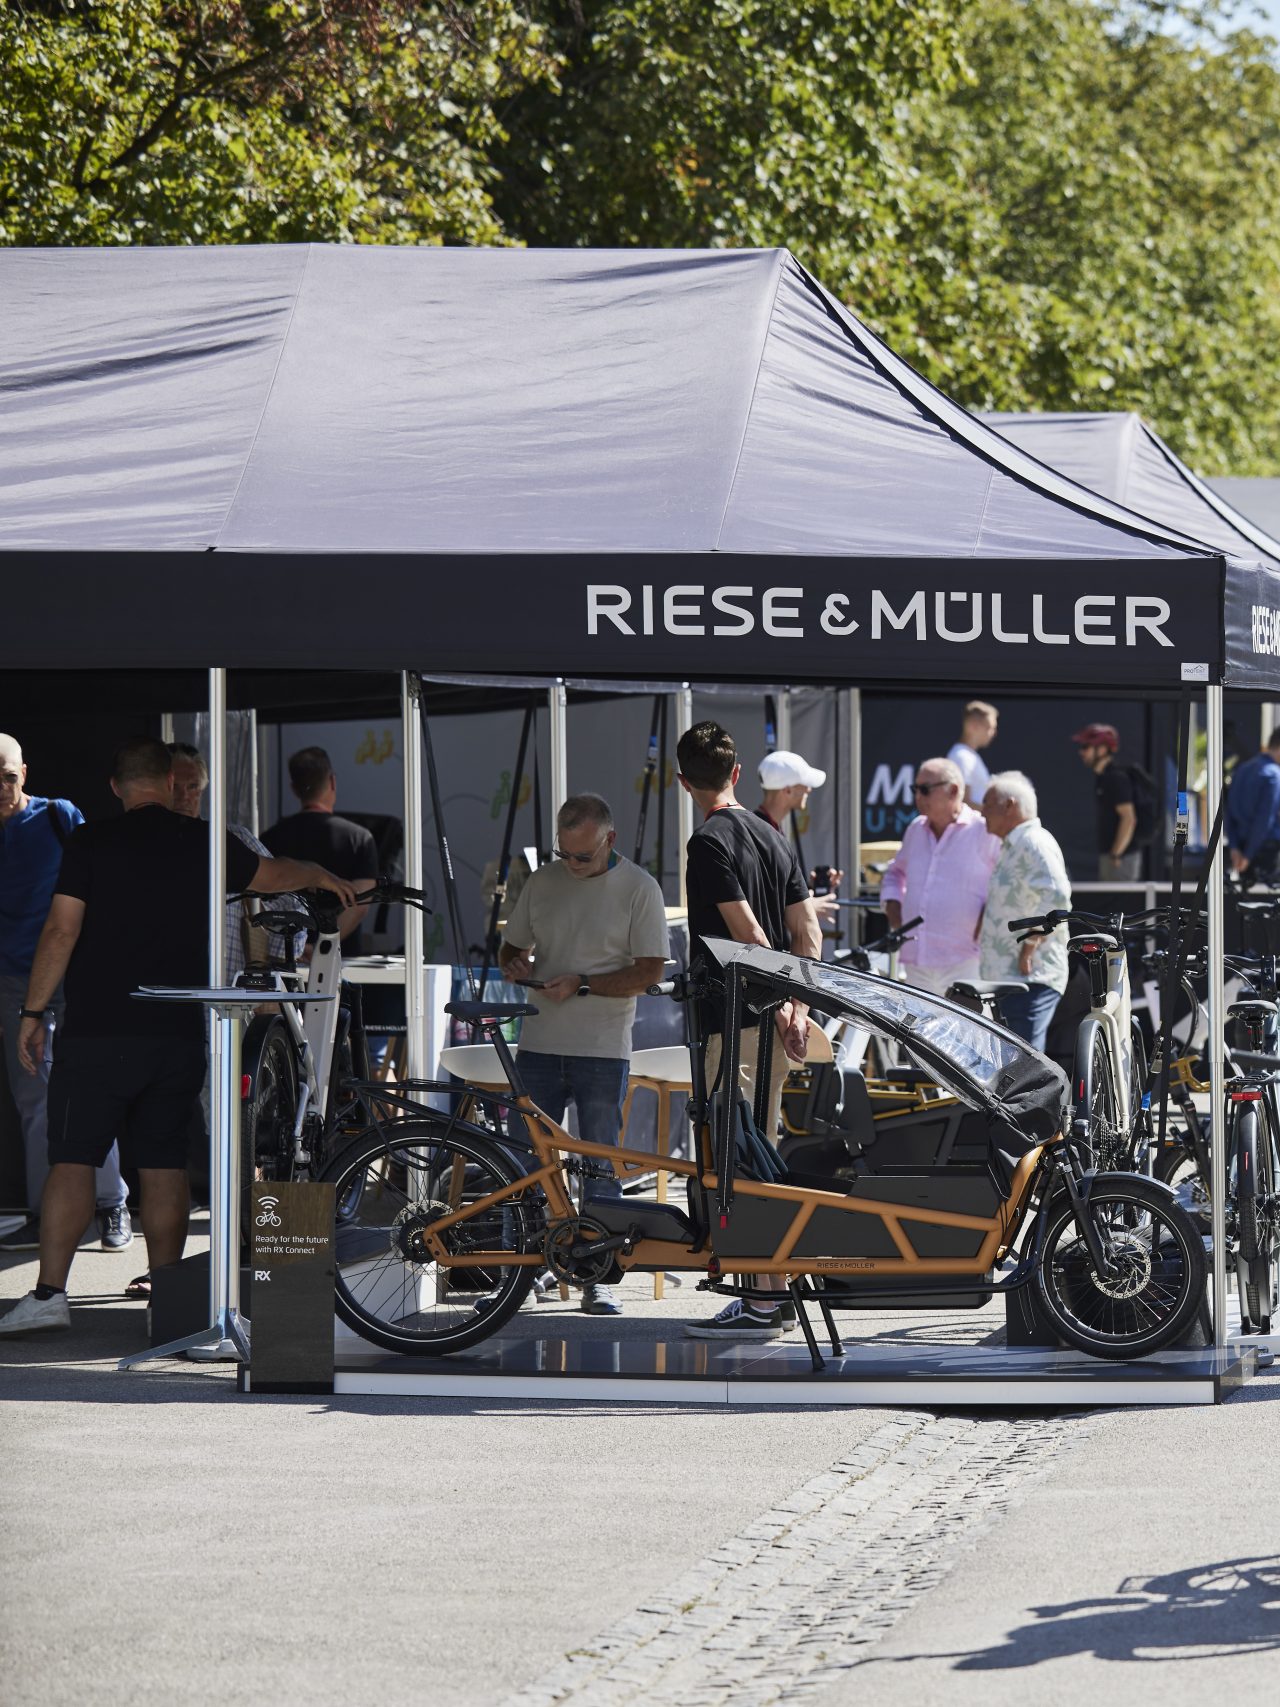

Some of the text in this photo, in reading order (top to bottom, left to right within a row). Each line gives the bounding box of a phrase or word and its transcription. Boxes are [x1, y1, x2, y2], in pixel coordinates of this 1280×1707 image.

[586, 584, 1176, 647] RIESE & MÜLLER
[255, 1235, 329, 1244] Ready for the future
[255, 1245, 315, 1254] with RX Connect
[254, 1270, 271, 1281] RX
